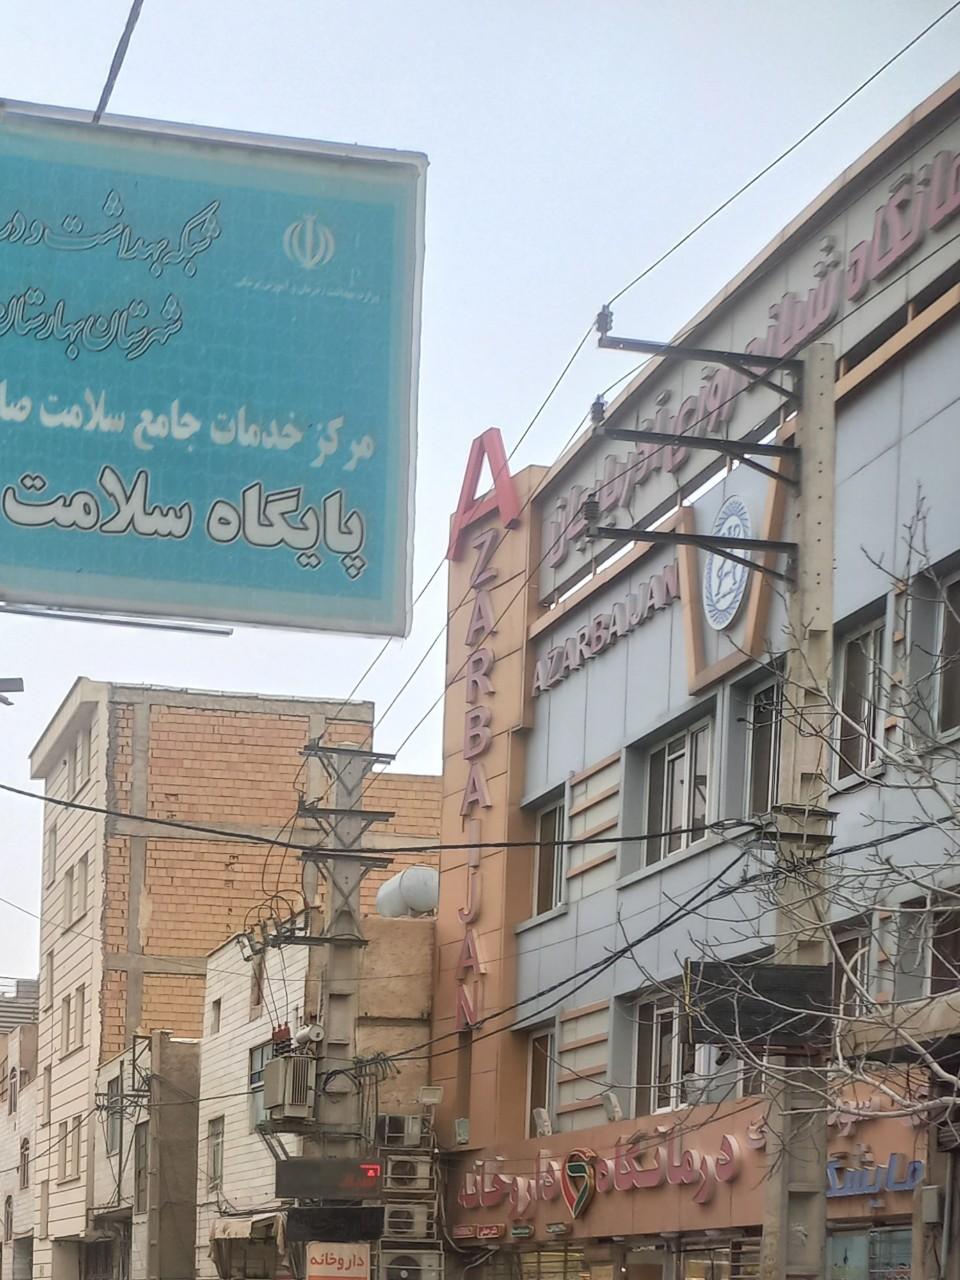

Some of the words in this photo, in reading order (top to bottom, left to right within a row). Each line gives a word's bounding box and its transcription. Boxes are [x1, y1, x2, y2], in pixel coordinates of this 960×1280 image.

[42, 188, 171, 278] بهداشت
[161, 199, 222, 278] شبکه
[81, 291, 184, 361] شهرستان
[39, 386, 125, 434] سلامت
[132, 397, 202, 453] جامع
[209, 404, 305, 451] خدمات
[309, 415, 376, 472] مرکز
[1, 463, 194, 540] سلامت
[205, 480, 367, 581] پایگاه
[597, 1124, 740, 1205] درمانگاه
[309, 1251, 365, 1271] داروخانه
